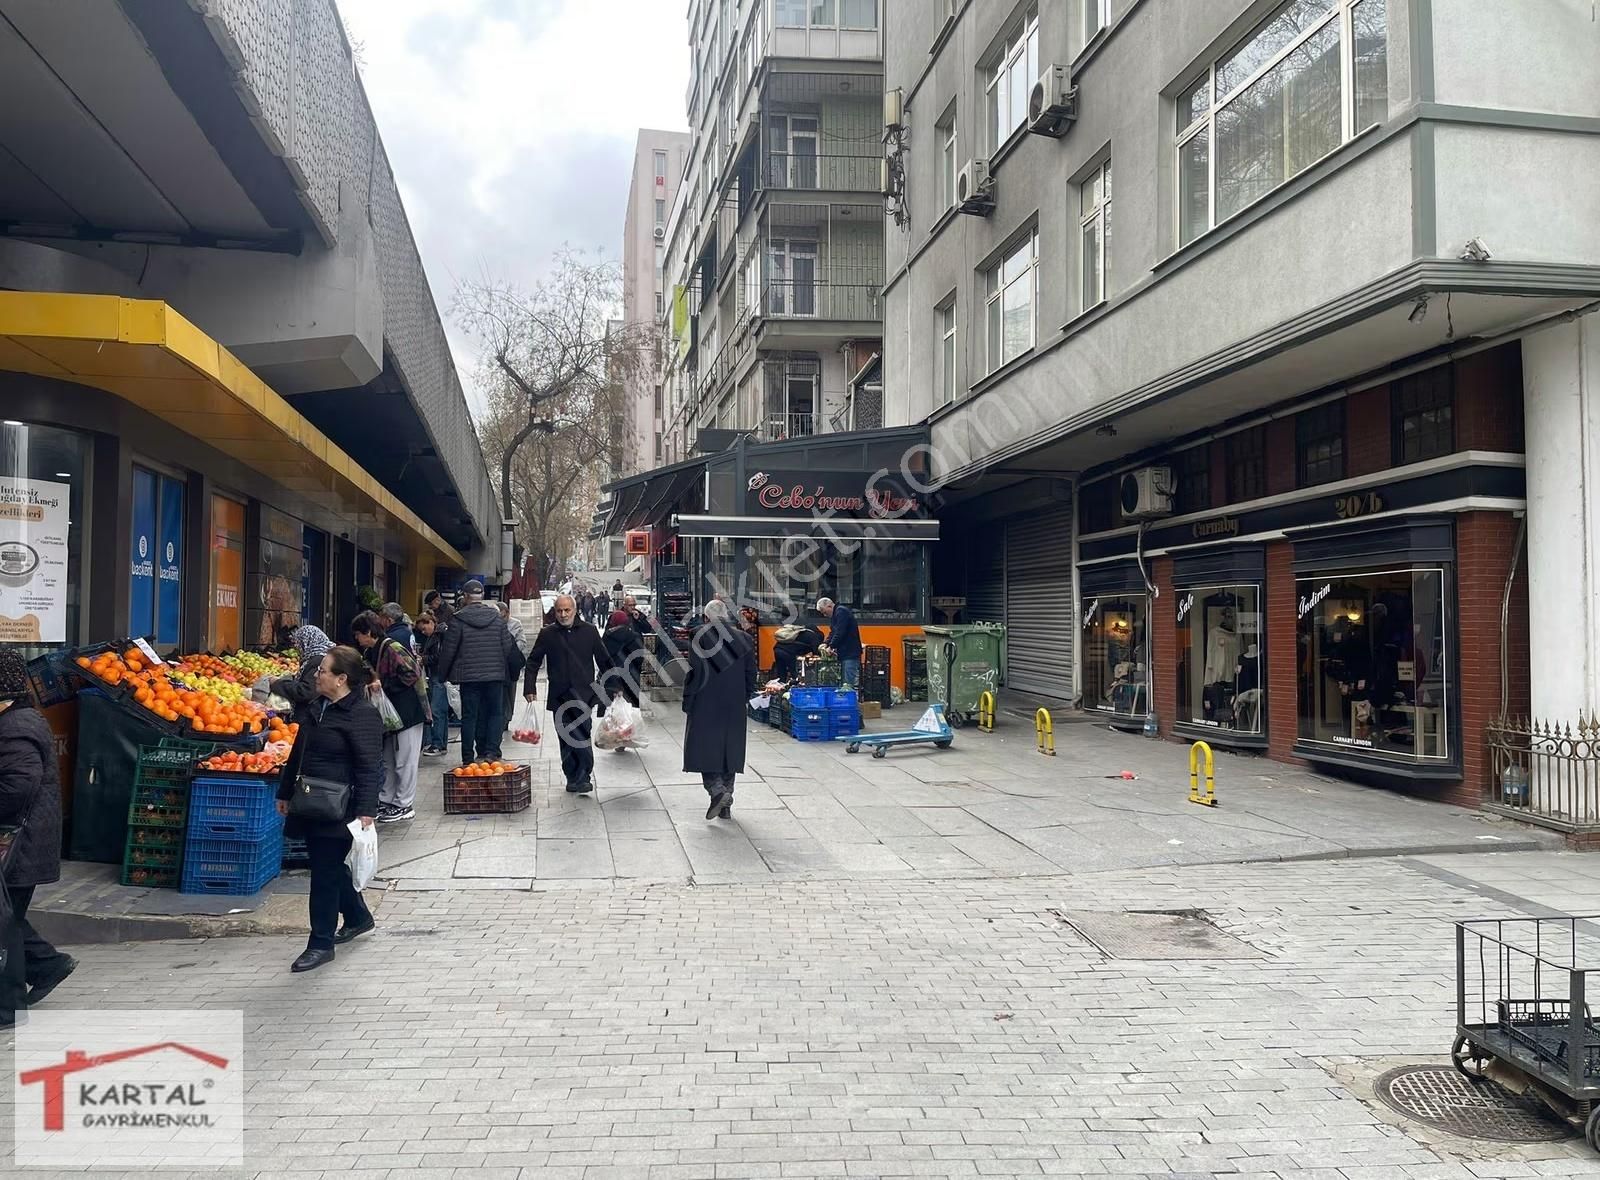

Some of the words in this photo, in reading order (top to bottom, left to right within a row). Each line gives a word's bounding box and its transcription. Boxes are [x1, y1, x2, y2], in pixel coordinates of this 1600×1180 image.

[1335, 491, 1383, 519] 20/b
[1192, 513, 1240, 537] Carnaby
[1177, 592, 1194, 621] Sale
